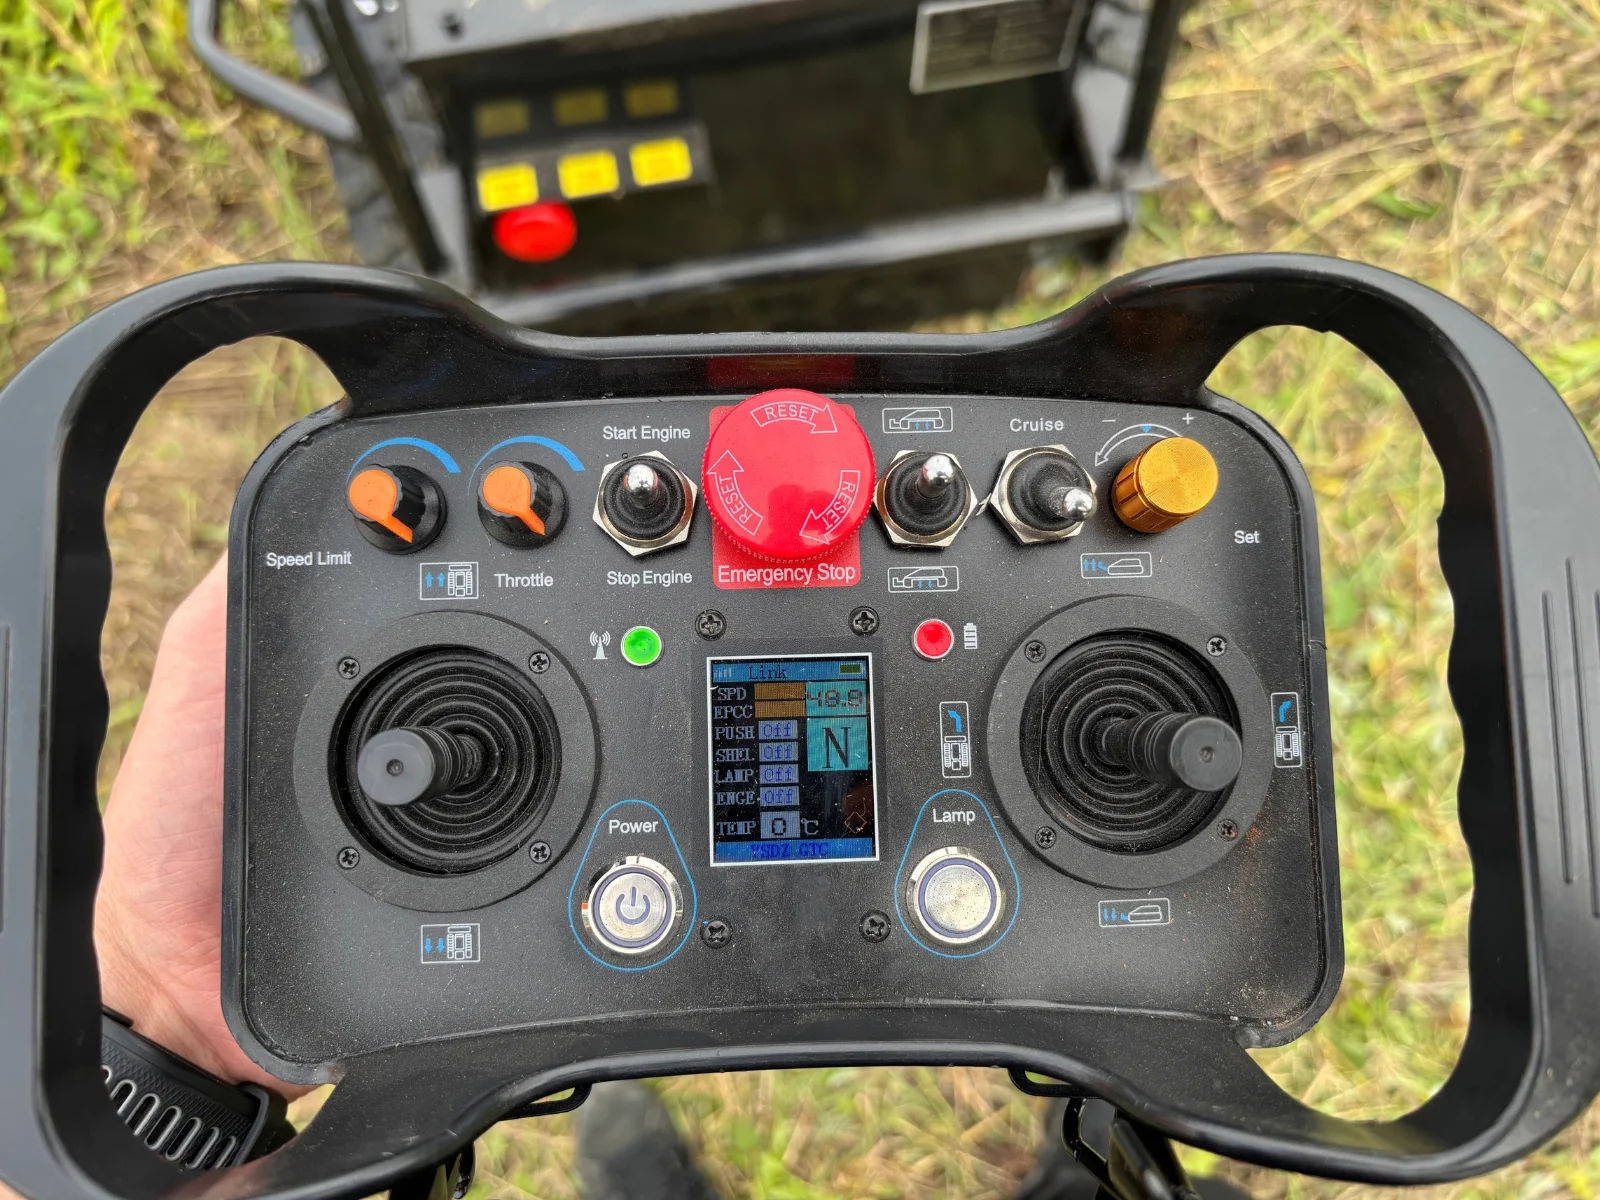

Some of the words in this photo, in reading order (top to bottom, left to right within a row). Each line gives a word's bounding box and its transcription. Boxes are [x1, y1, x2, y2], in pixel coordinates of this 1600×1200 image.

[764, 404, 818, 422] RESET
[602, 426, 638, 440] Start
[641, 424, 691, 441] Engine
[1009, 418, 1064, 432] Cruise
[719, 475, 752, 525] RESET
[821, 481, 856, 531] RESET
[1234, 530, 1260, 545] Set
[266, 552, 313, 568] Speed
[317, 550, 352, 566] Limit
[494, 573, 554, 588] Throttle
[606, 570, 641, 588] Stop
[643, 569, 693, 587] Engine
[718, 565, 813, 586] Emergency
[817, 563, 856, 583] Stop
[748, 665, 787, 680] Link
[717, 687, 747, 701] SPD
[713, 705, 753, 719] EPCC
[714, 726, 755, 740] PUSH
[763, 722, 792, 738] Off
[715, 747, 755, 762] SHEL
[763, 744, 793, 760] Off
[822, 726, 851, 769] N
[714, 768, 754, 784] LAMP
[764, 766, 793, 782] Off
[764, 788, 794, 804] Off
[932, 809, 976, 825] Lamp
[608, 819, 659, 835] Power
[716, 820, 757, 836] TEMP
[799, 842, 830, 857] GTC
